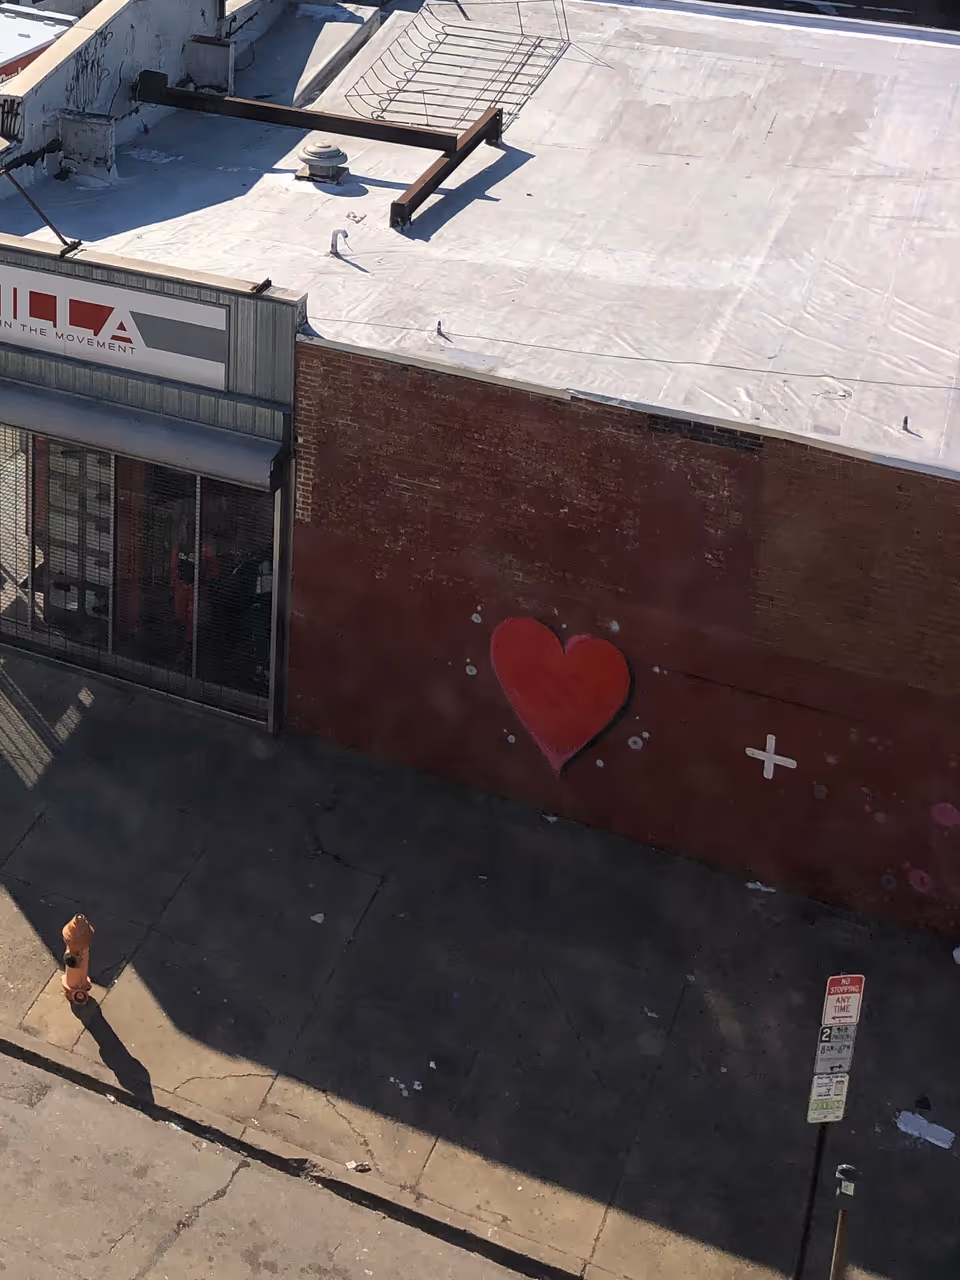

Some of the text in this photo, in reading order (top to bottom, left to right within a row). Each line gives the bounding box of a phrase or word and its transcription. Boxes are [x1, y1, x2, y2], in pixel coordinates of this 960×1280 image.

[20, 323, 47, 338] THE
[55, 331, 137, 355] MOVEMENT
[840, 977, 851, 985] NO
[830, 984, 860, 994] STOPPING
[835, 995, 852, 1005] ANY
[833, 1004, 852, 1013] TIME
[821, 1028, 831, 1041] 2
